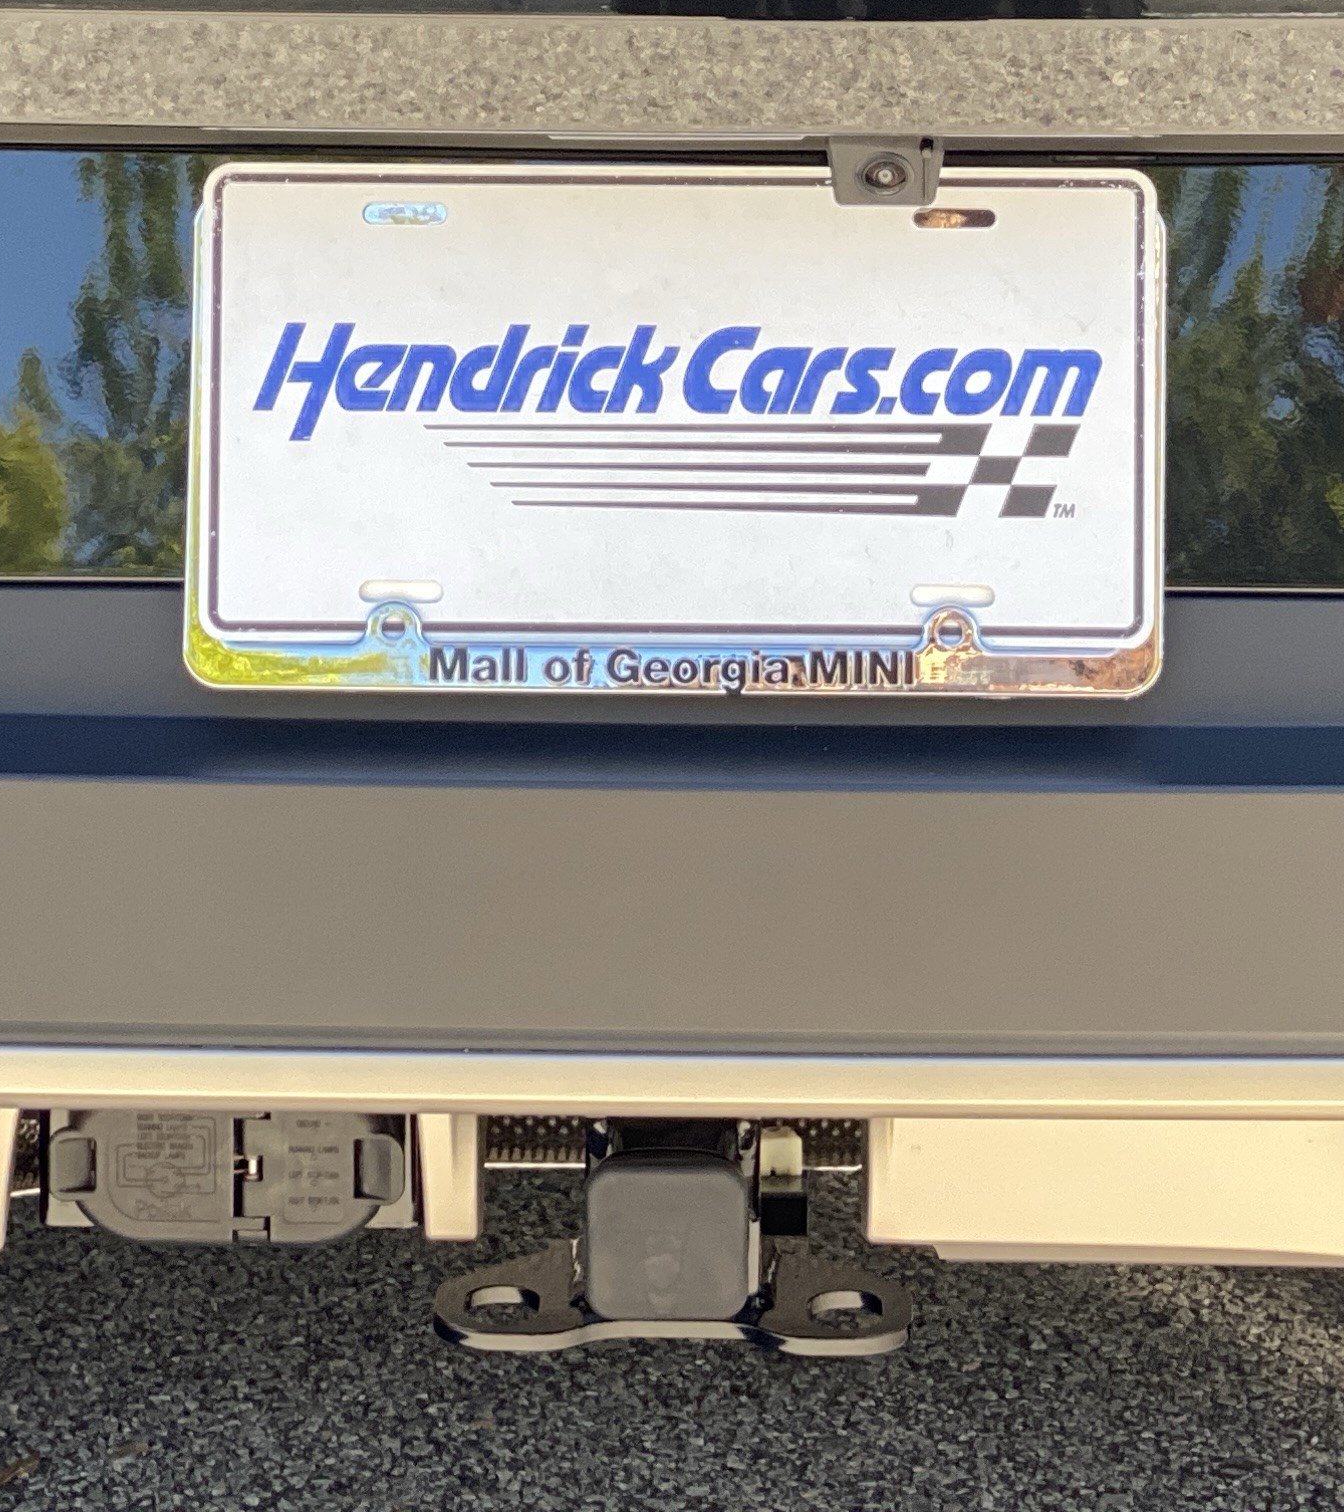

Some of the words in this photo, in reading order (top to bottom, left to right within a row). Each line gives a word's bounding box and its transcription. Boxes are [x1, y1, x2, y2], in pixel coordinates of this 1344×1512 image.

[1053, 503, 1076, 518] TM
[428, 645, 526, 684] Mall
[543, 648, 589, 684] of
[605, 647, 791, 691] Georgia
[808, 649, 916, 686] MINI
